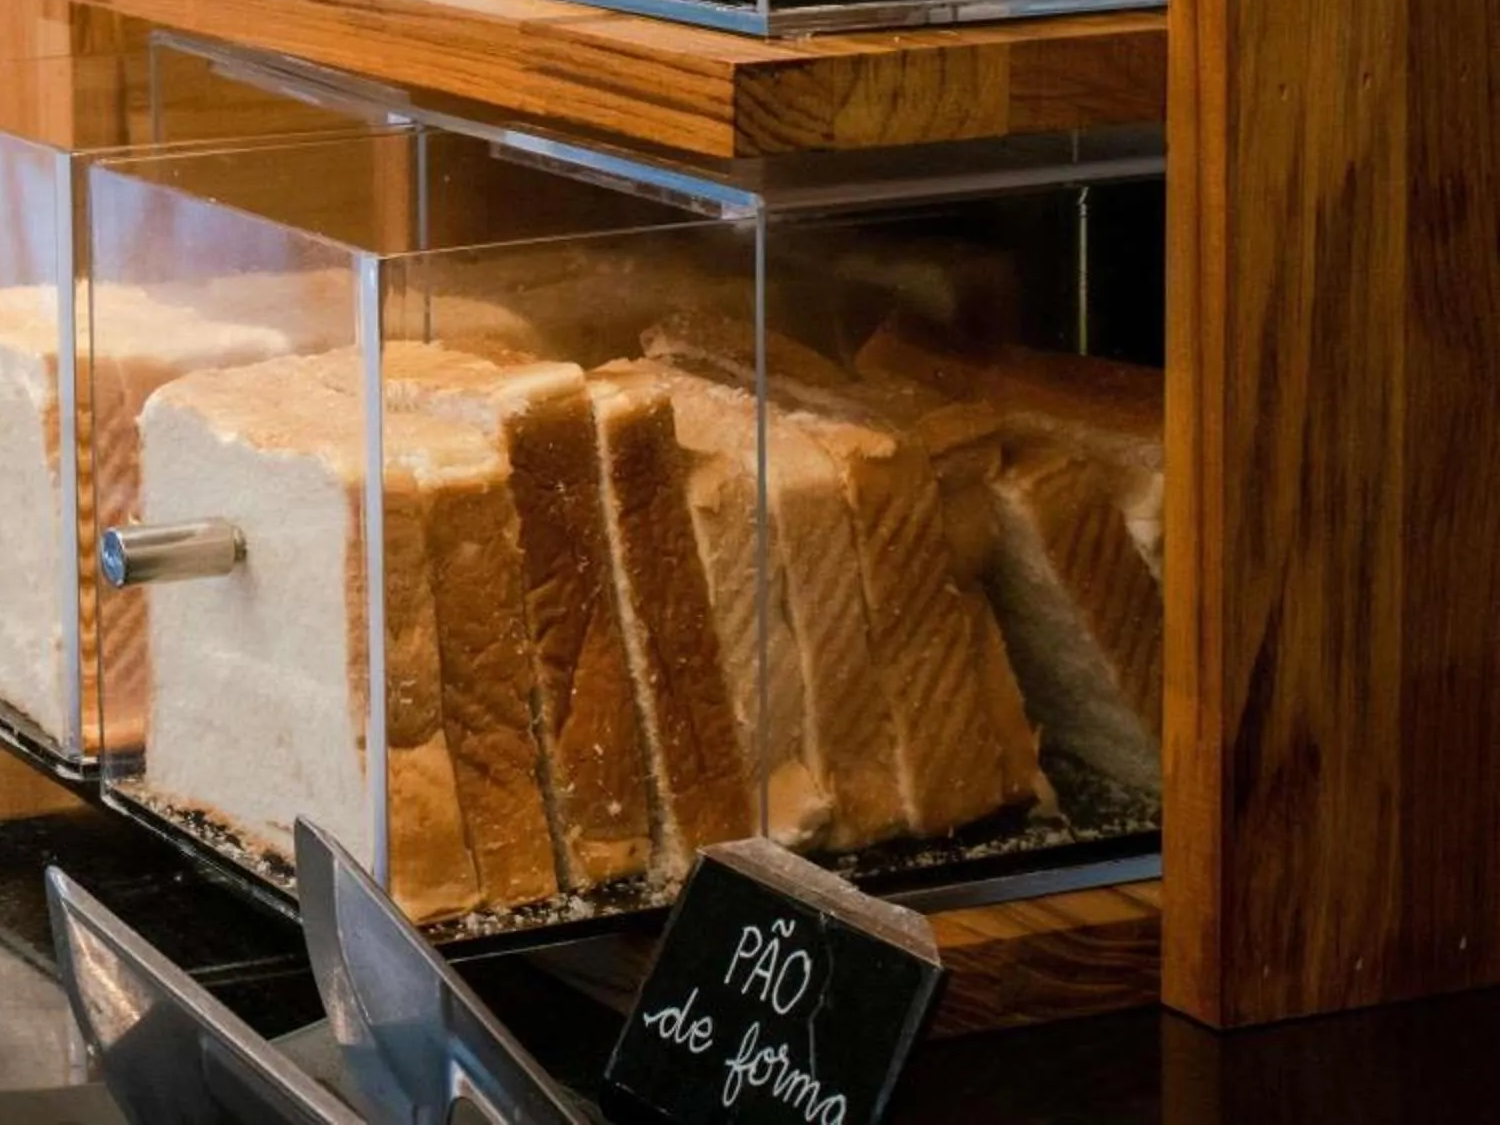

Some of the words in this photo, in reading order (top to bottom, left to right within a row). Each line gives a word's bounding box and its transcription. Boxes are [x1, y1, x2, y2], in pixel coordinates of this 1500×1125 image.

[723, 918, 812, 1015] PÃO
[643, 987, 714, 1053] de
[722, 1021, 848, 1125] forma
